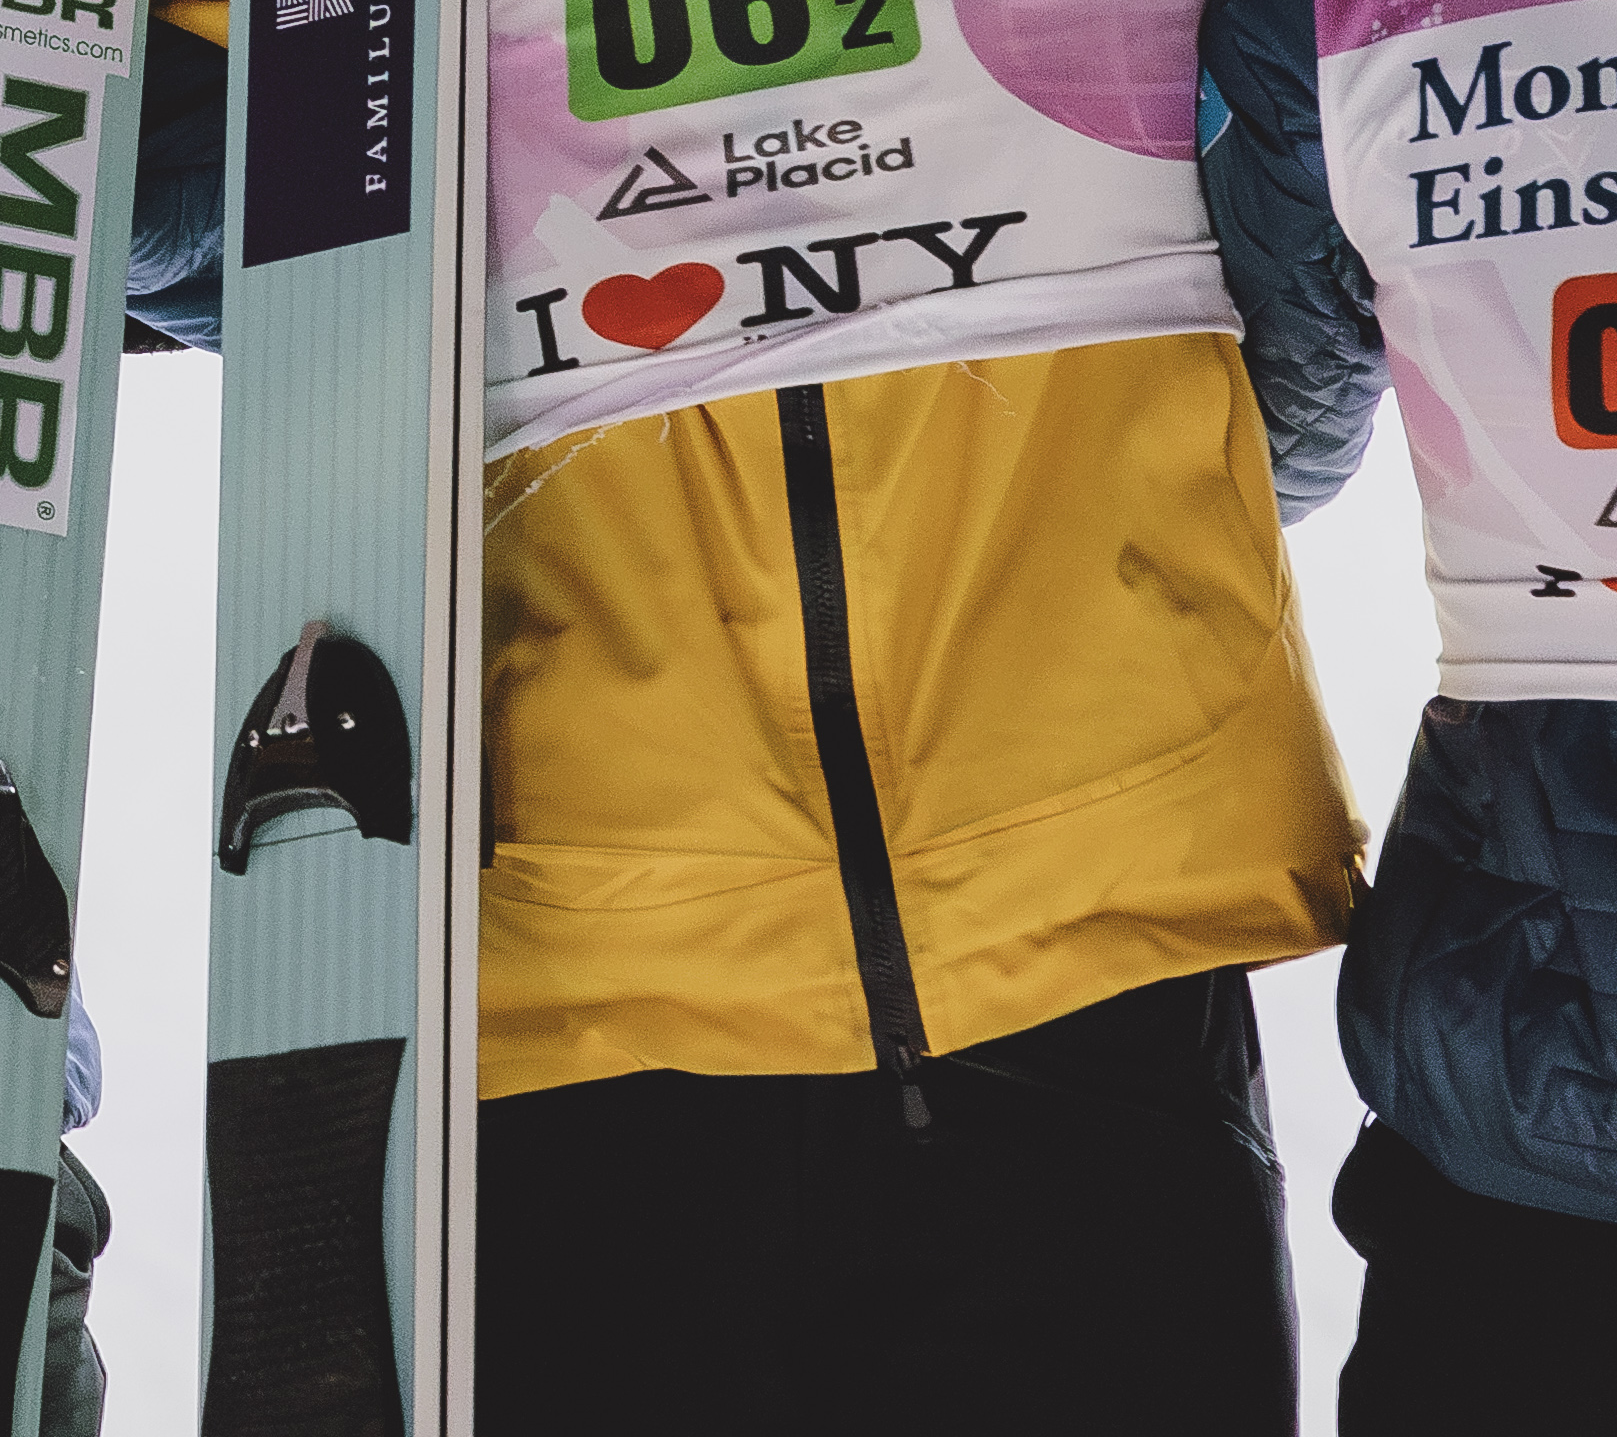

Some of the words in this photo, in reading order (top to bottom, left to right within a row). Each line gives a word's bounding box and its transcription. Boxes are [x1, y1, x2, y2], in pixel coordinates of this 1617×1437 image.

[723, 115, 864, 165] Lake
[724, 138, 917, 201] Placid
[515, 287, 579, 378] I
